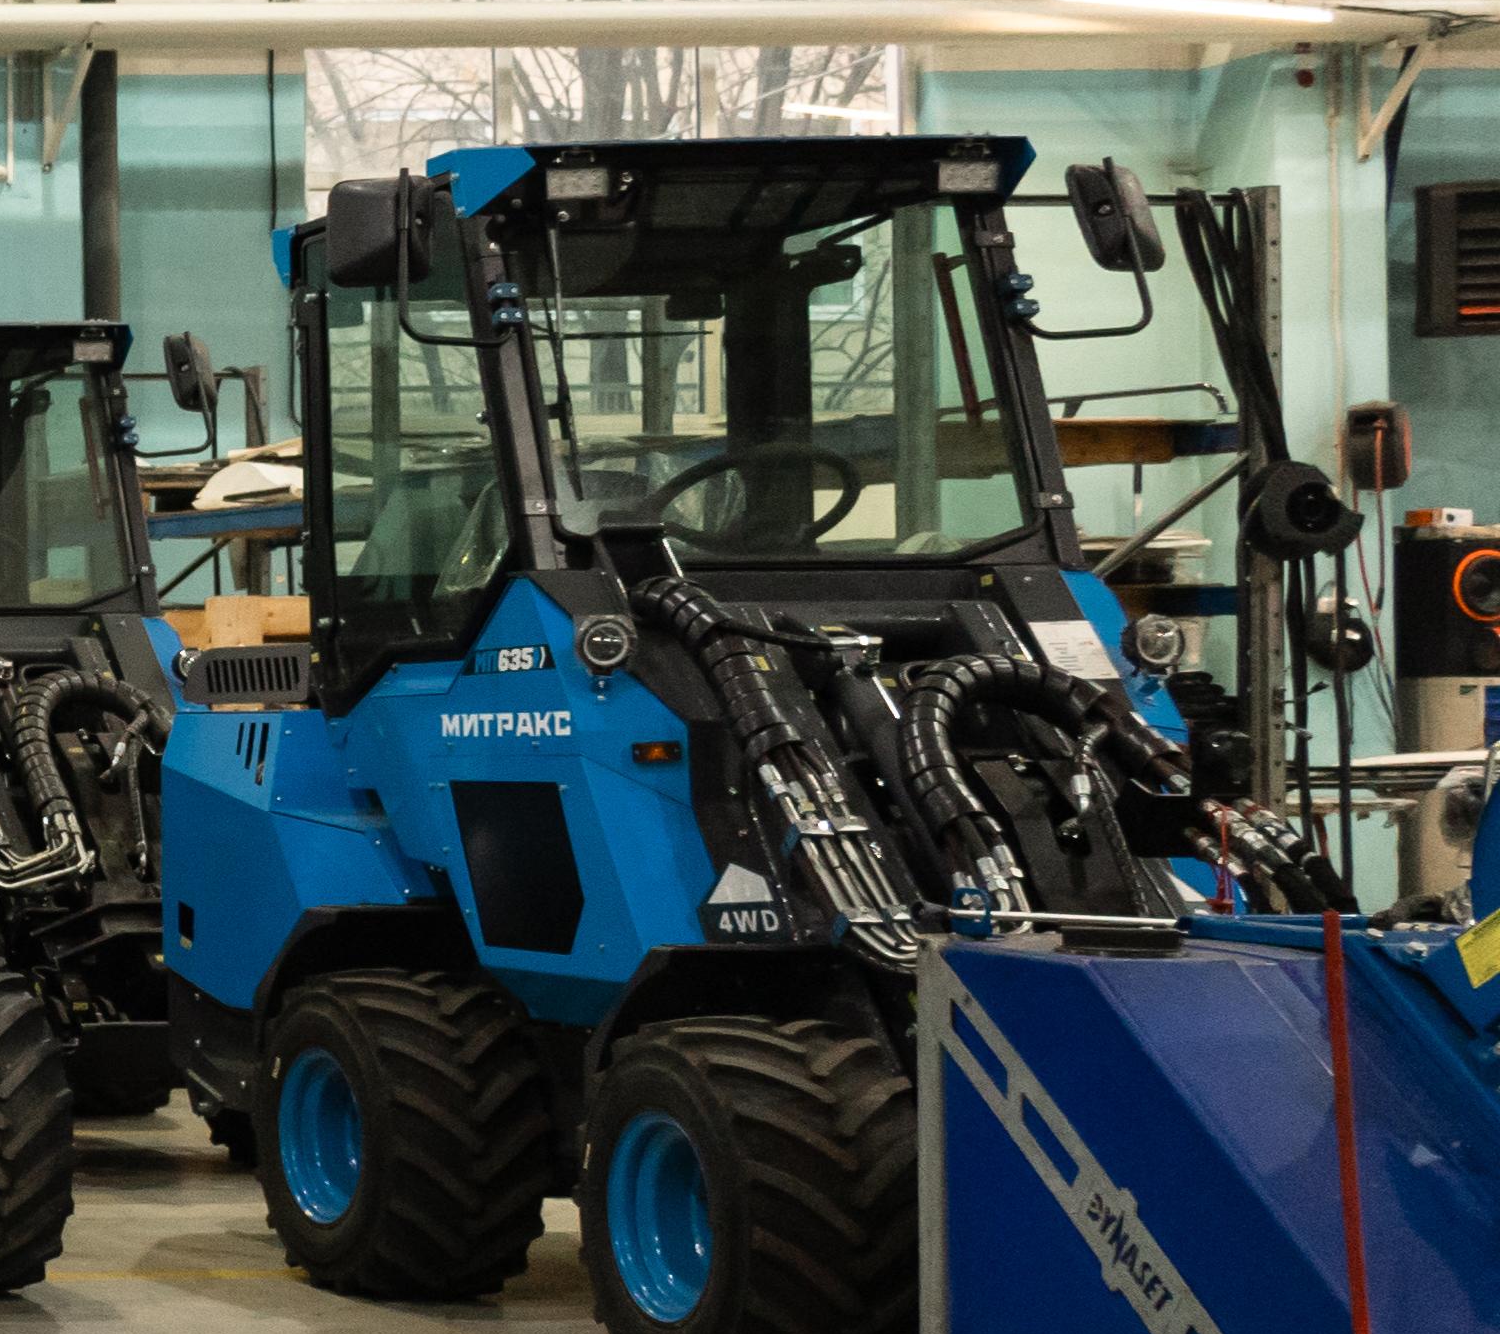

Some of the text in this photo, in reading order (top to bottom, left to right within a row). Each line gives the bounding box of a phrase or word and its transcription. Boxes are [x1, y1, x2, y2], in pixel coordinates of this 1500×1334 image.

[440, 710, 572, 737] МИТРАКС
[719, 909, 780, 933] 4WD
[1086, 1192, 1174, 1312] DYNASET
